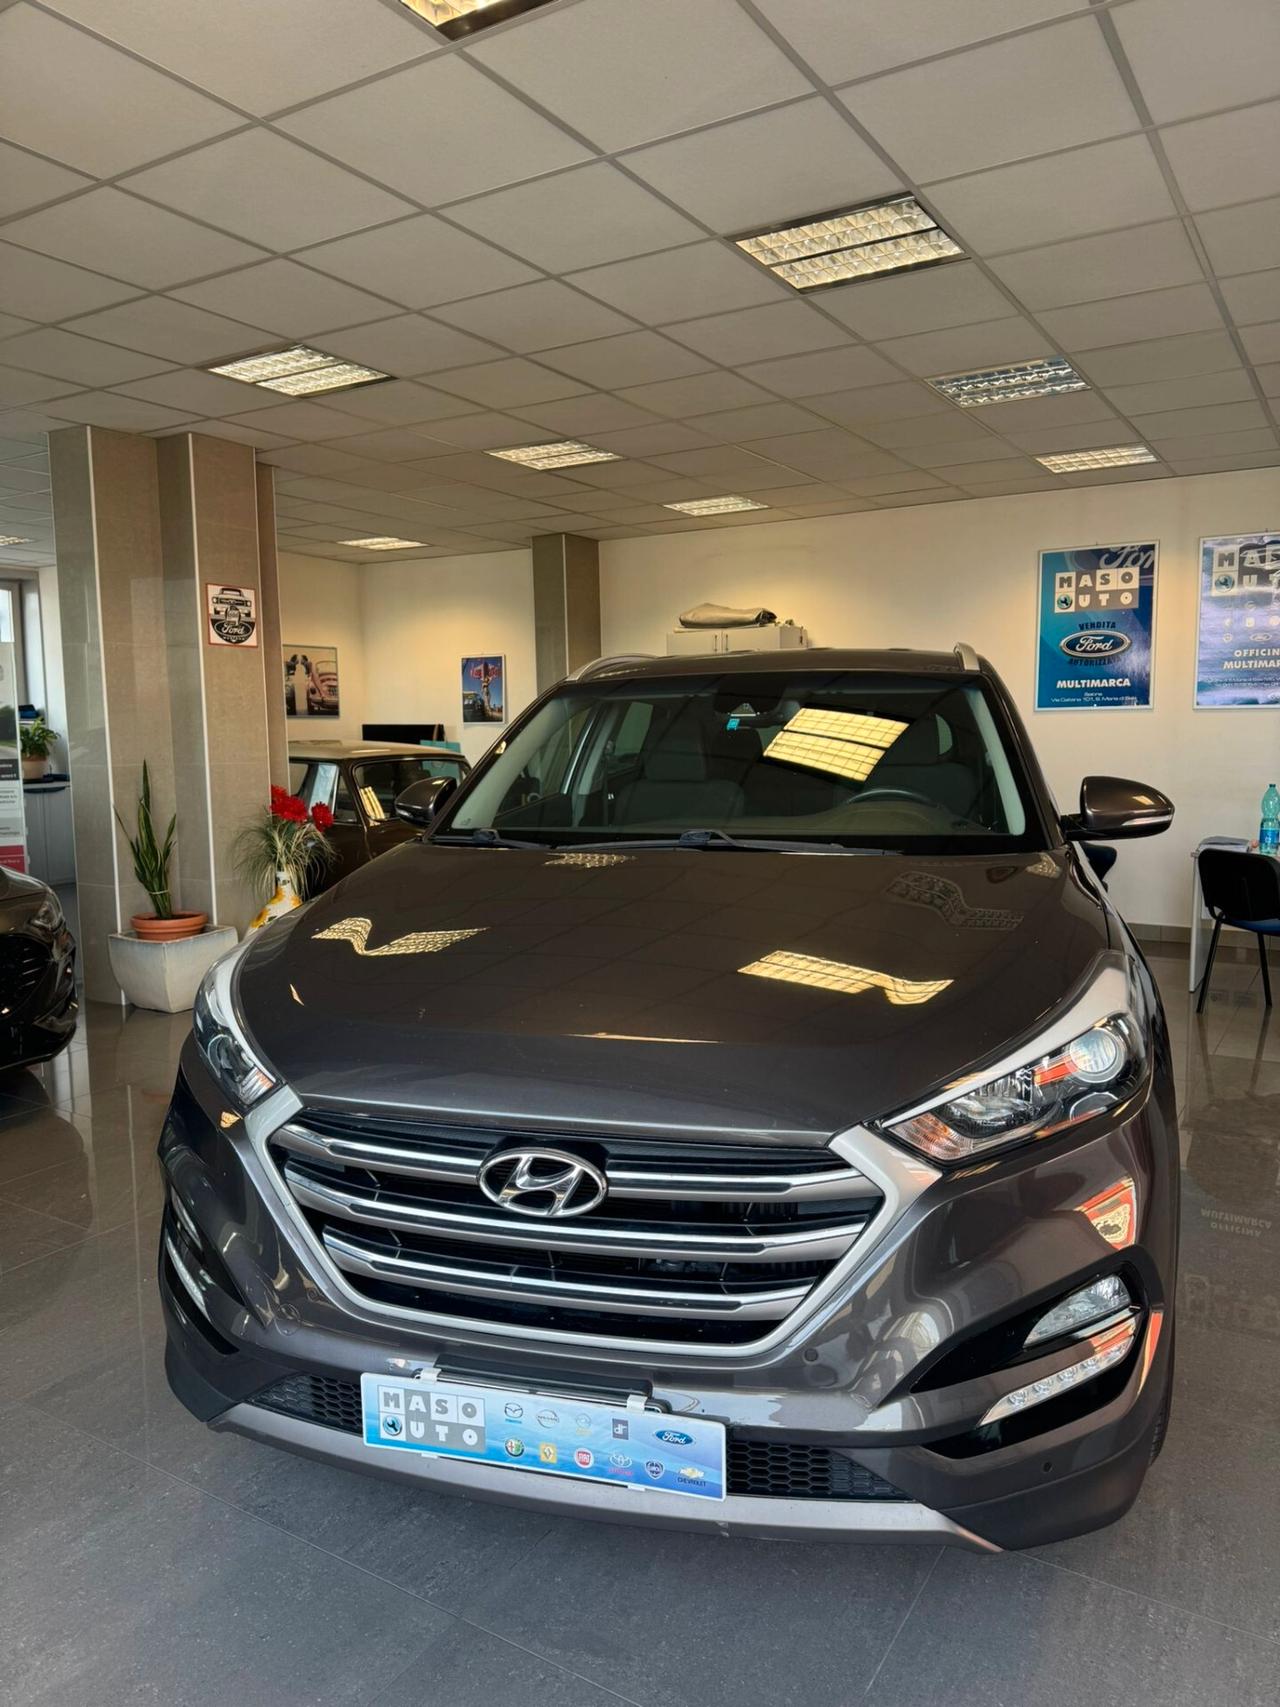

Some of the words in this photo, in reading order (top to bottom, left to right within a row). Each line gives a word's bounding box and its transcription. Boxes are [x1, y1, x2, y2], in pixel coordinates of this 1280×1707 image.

[1059, 571, 1134, 589] MASO
[222, 622, 245, 633] Ford
[1078, 621, 1116, 630] VENDITA
[1076, 636, 1114, 651] Ford
[1056, 678, 1131, 689] MULTIMARCA
[383, 1391, 477, 1419] MASO
[662, 1431, 686, 1445] Ford
